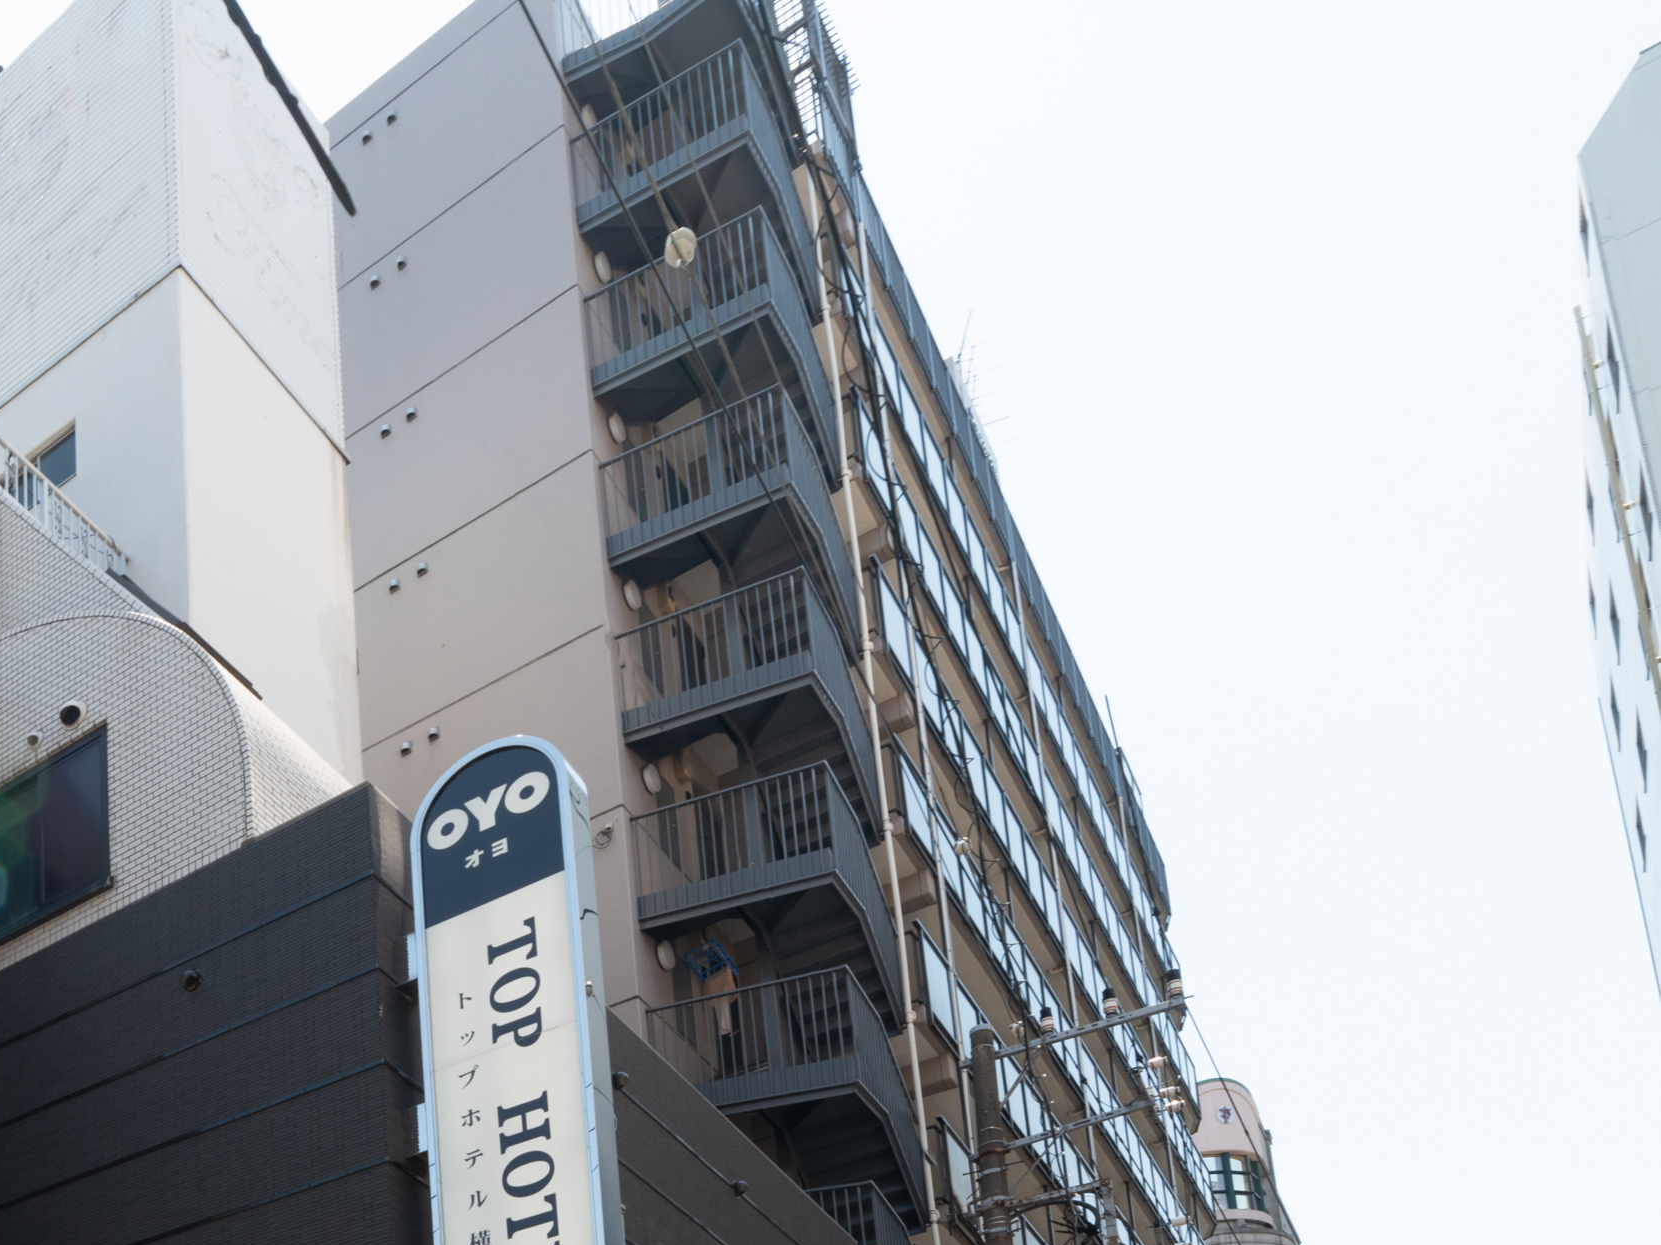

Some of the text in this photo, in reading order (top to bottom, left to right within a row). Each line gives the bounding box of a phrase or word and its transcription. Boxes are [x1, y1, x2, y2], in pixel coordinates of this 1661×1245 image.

[426, 770, 551, 851] OYO
[464, 837, 510, 869] オヨ
[487, 916, 542, 1048] TOP
